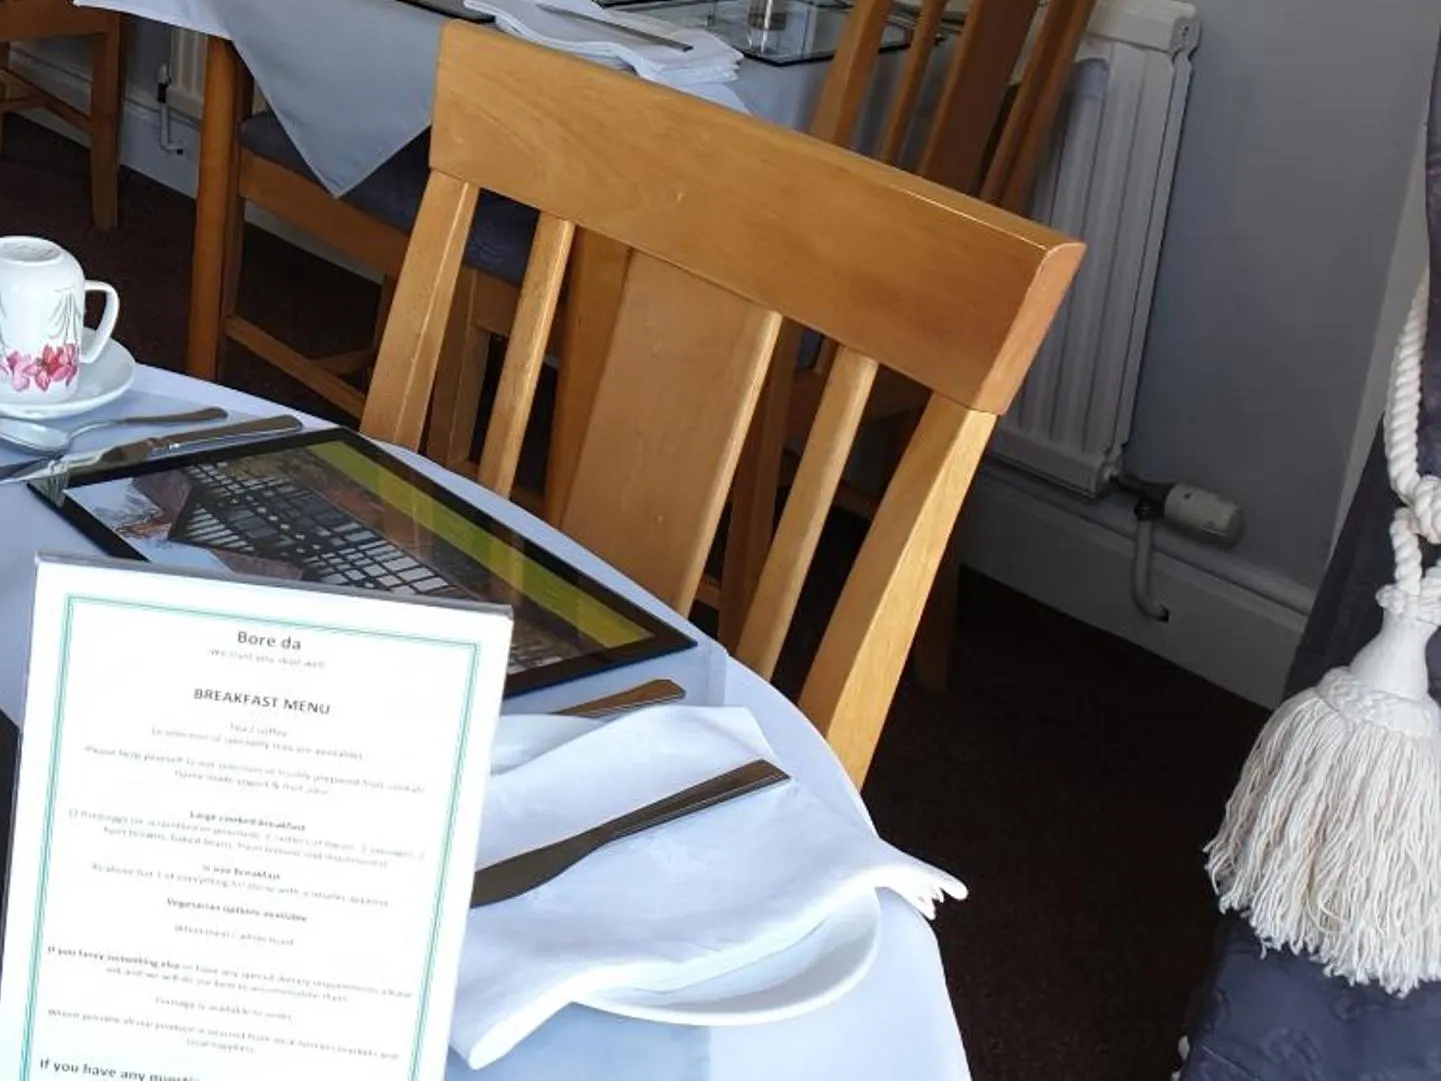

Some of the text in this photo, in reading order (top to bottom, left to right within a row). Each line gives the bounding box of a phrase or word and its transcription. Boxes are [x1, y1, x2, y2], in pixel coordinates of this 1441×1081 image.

[236, 630, 302, 651] Bore da
[193, 687, 331, 715] BREAKFAST MENU
[40, 1057, 50, 1070] If
[53, 1061, 80, 1075] you
[81, 1063, 117, 1078] have
[120, 1071, 145, 1081] any
